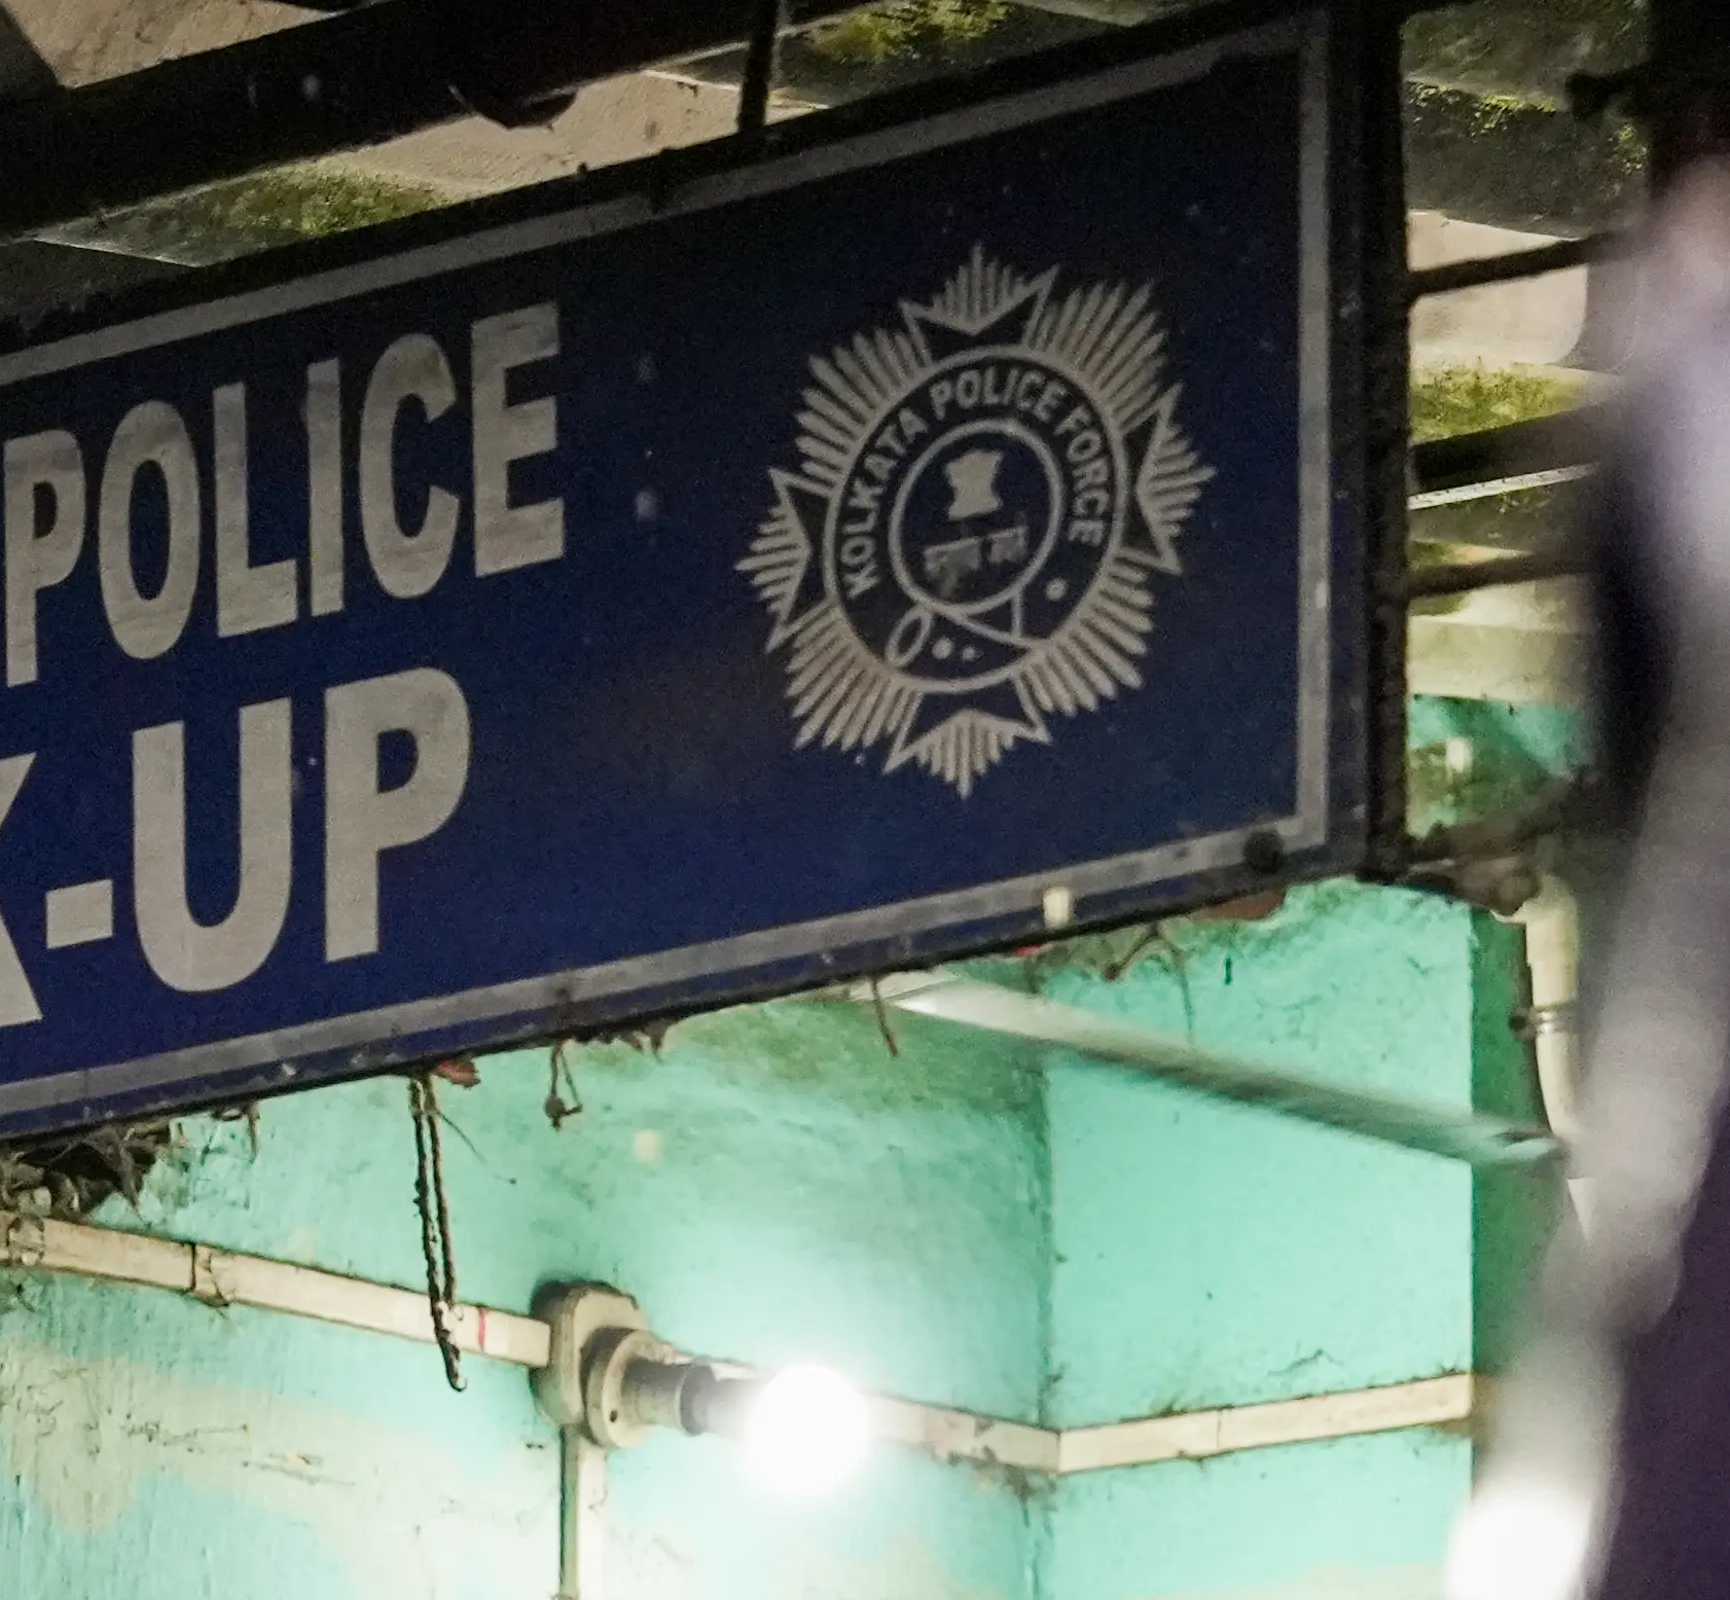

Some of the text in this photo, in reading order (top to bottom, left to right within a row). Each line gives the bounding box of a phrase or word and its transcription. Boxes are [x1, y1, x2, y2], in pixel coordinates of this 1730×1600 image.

[3, 301, 565, 687] POLICE
[839, 407, 928, 600] KOLKATA
[930, 367, 1069, 423] POLICE
[1053, 405, 1111, 547] FORCE
